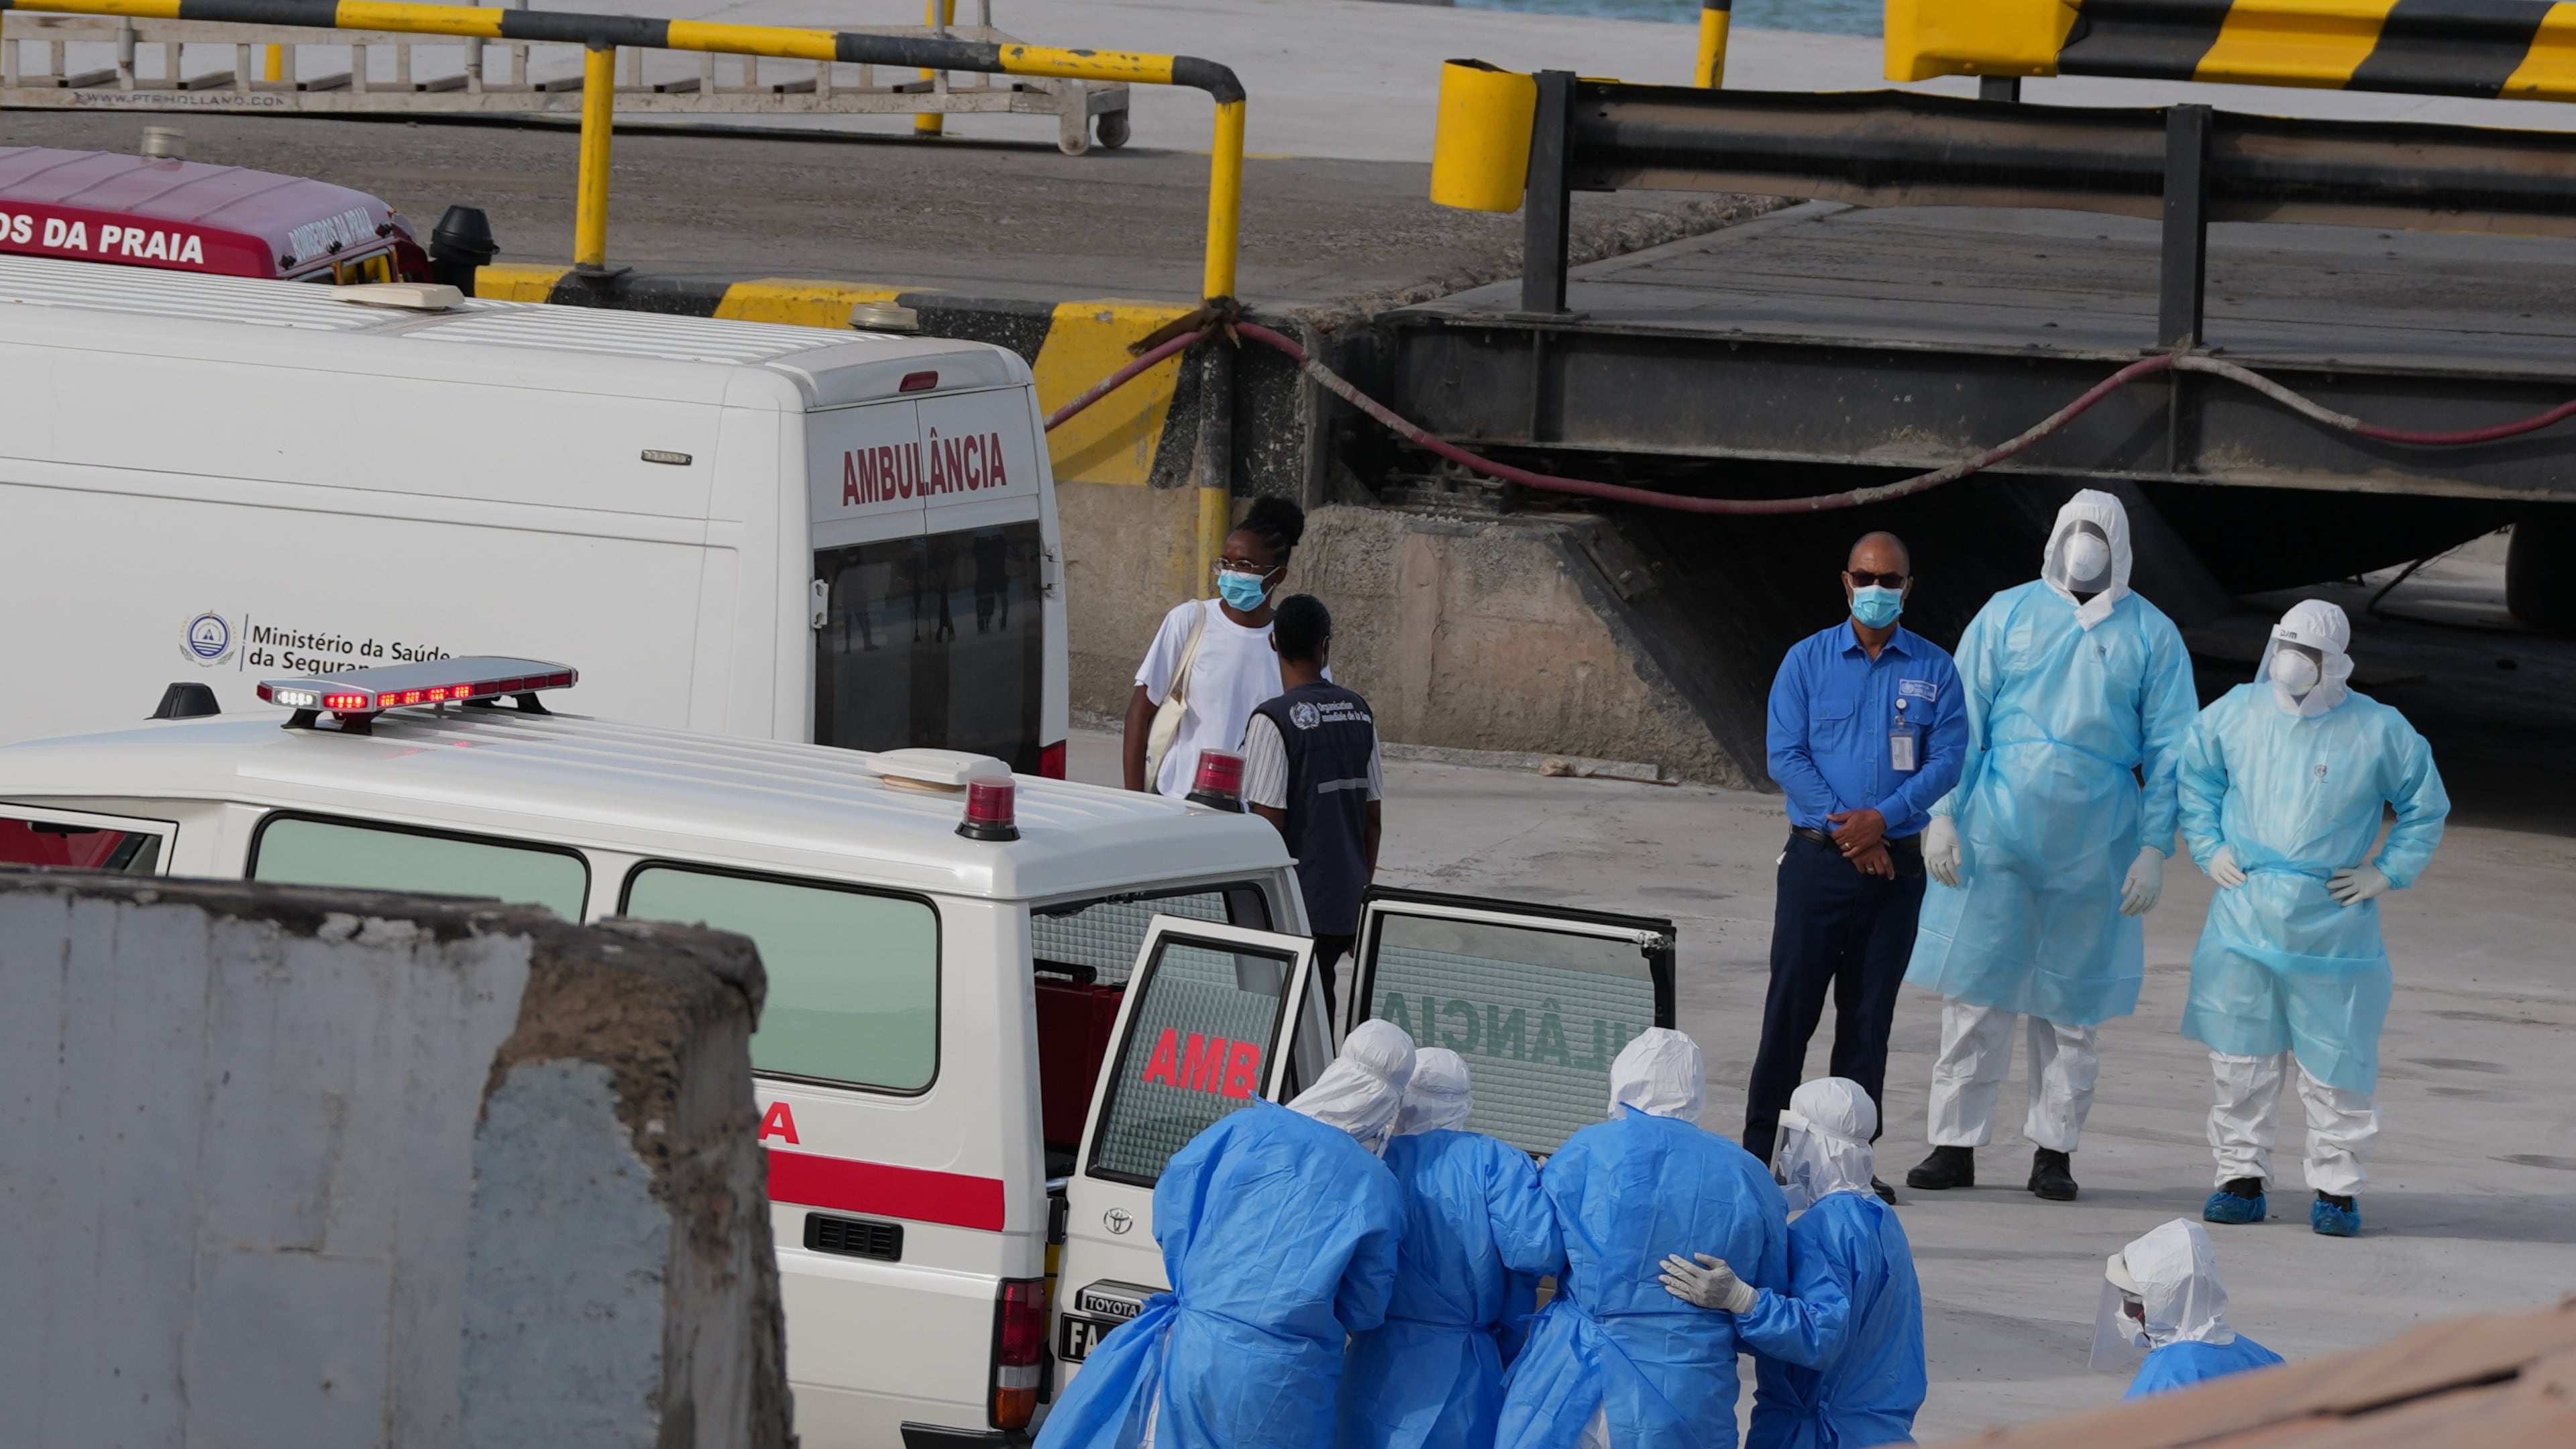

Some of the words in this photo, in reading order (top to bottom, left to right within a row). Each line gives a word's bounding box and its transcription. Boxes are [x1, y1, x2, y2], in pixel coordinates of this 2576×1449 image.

[43, 218, 88, 251] DA
[99, 225, 204, 264] PRAIA
[843, 427, 1008, 506] AMBULÂNCIA
[249, 647, 274, 667] da
[252, 625, 354, 653] Ministério
[360, 638, 384, 657] da
[1142, 1028, 1261, 1099] AMB
[1088, 1296, 1138, 1317] TOYOTA
